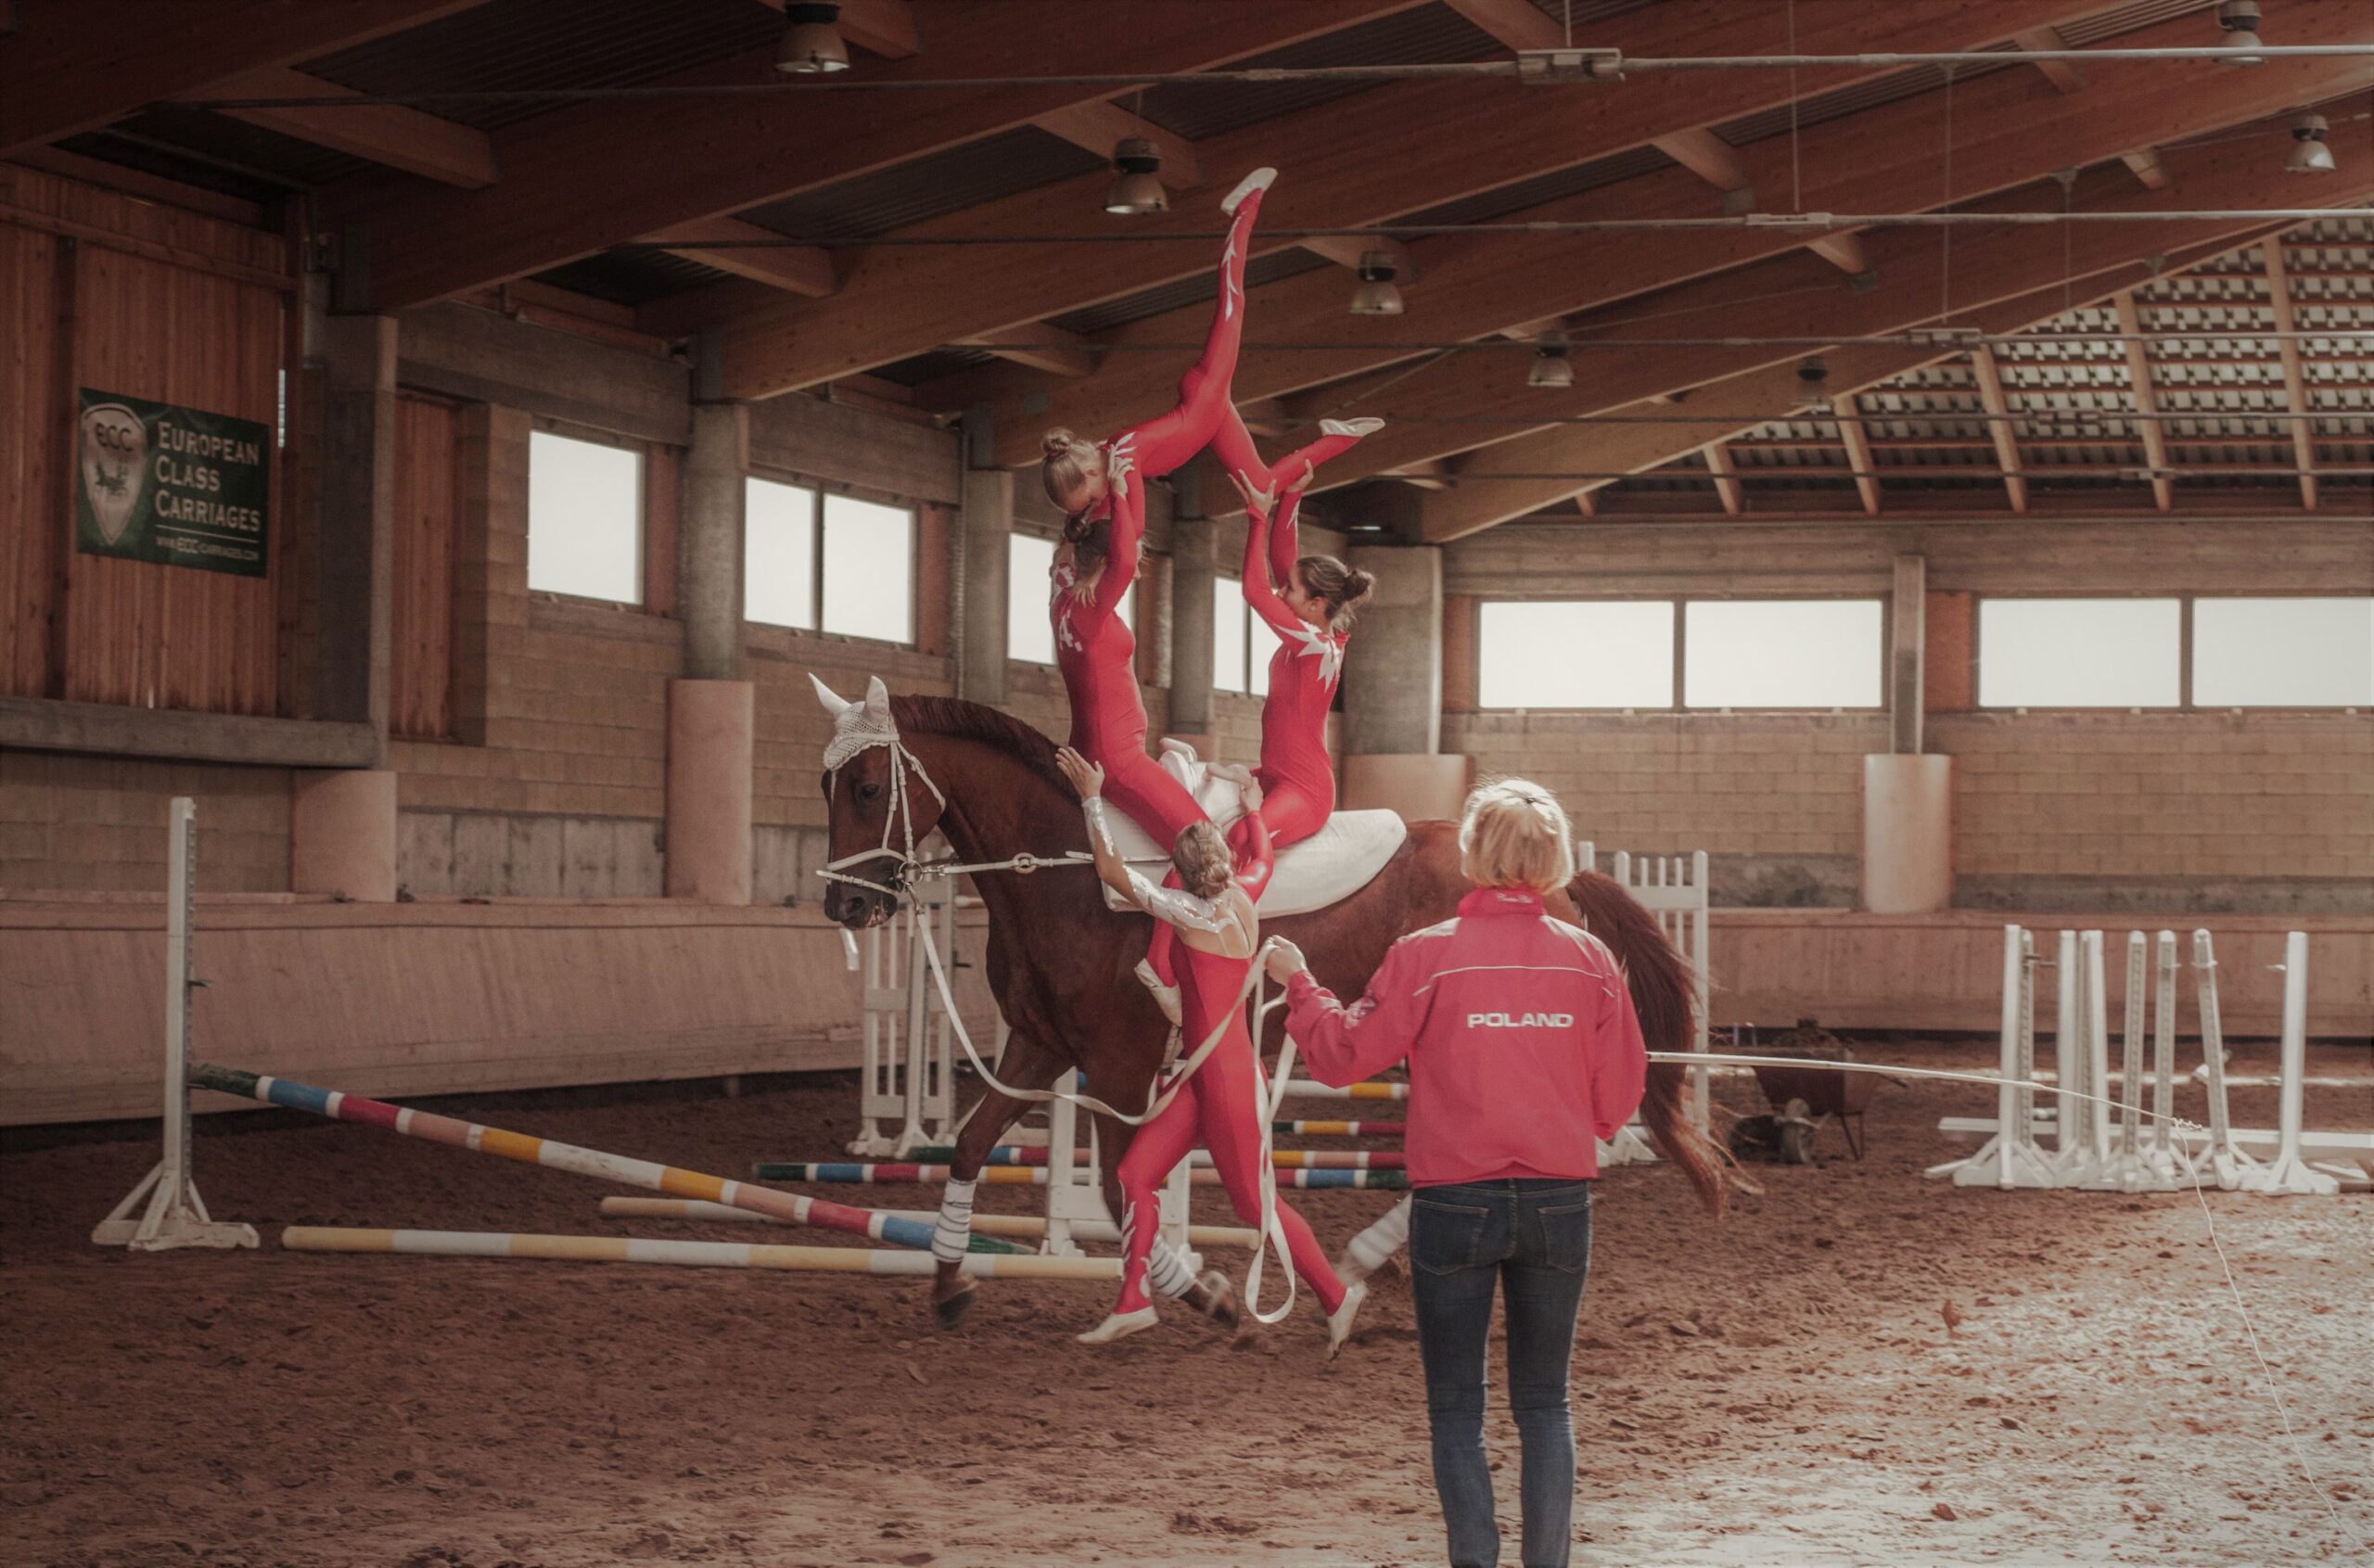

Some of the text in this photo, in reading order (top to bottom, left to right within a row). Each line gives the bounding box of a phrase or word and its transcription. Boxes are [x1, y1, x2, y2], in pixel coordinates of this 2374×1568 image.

[158, 421, 260, 465] EUROPEAN
[155, 454, 221, 491] CLASS
[155, 490, 261, 531] CARRIAGES
[1466, 1013, 1575, 1028] POLAND
